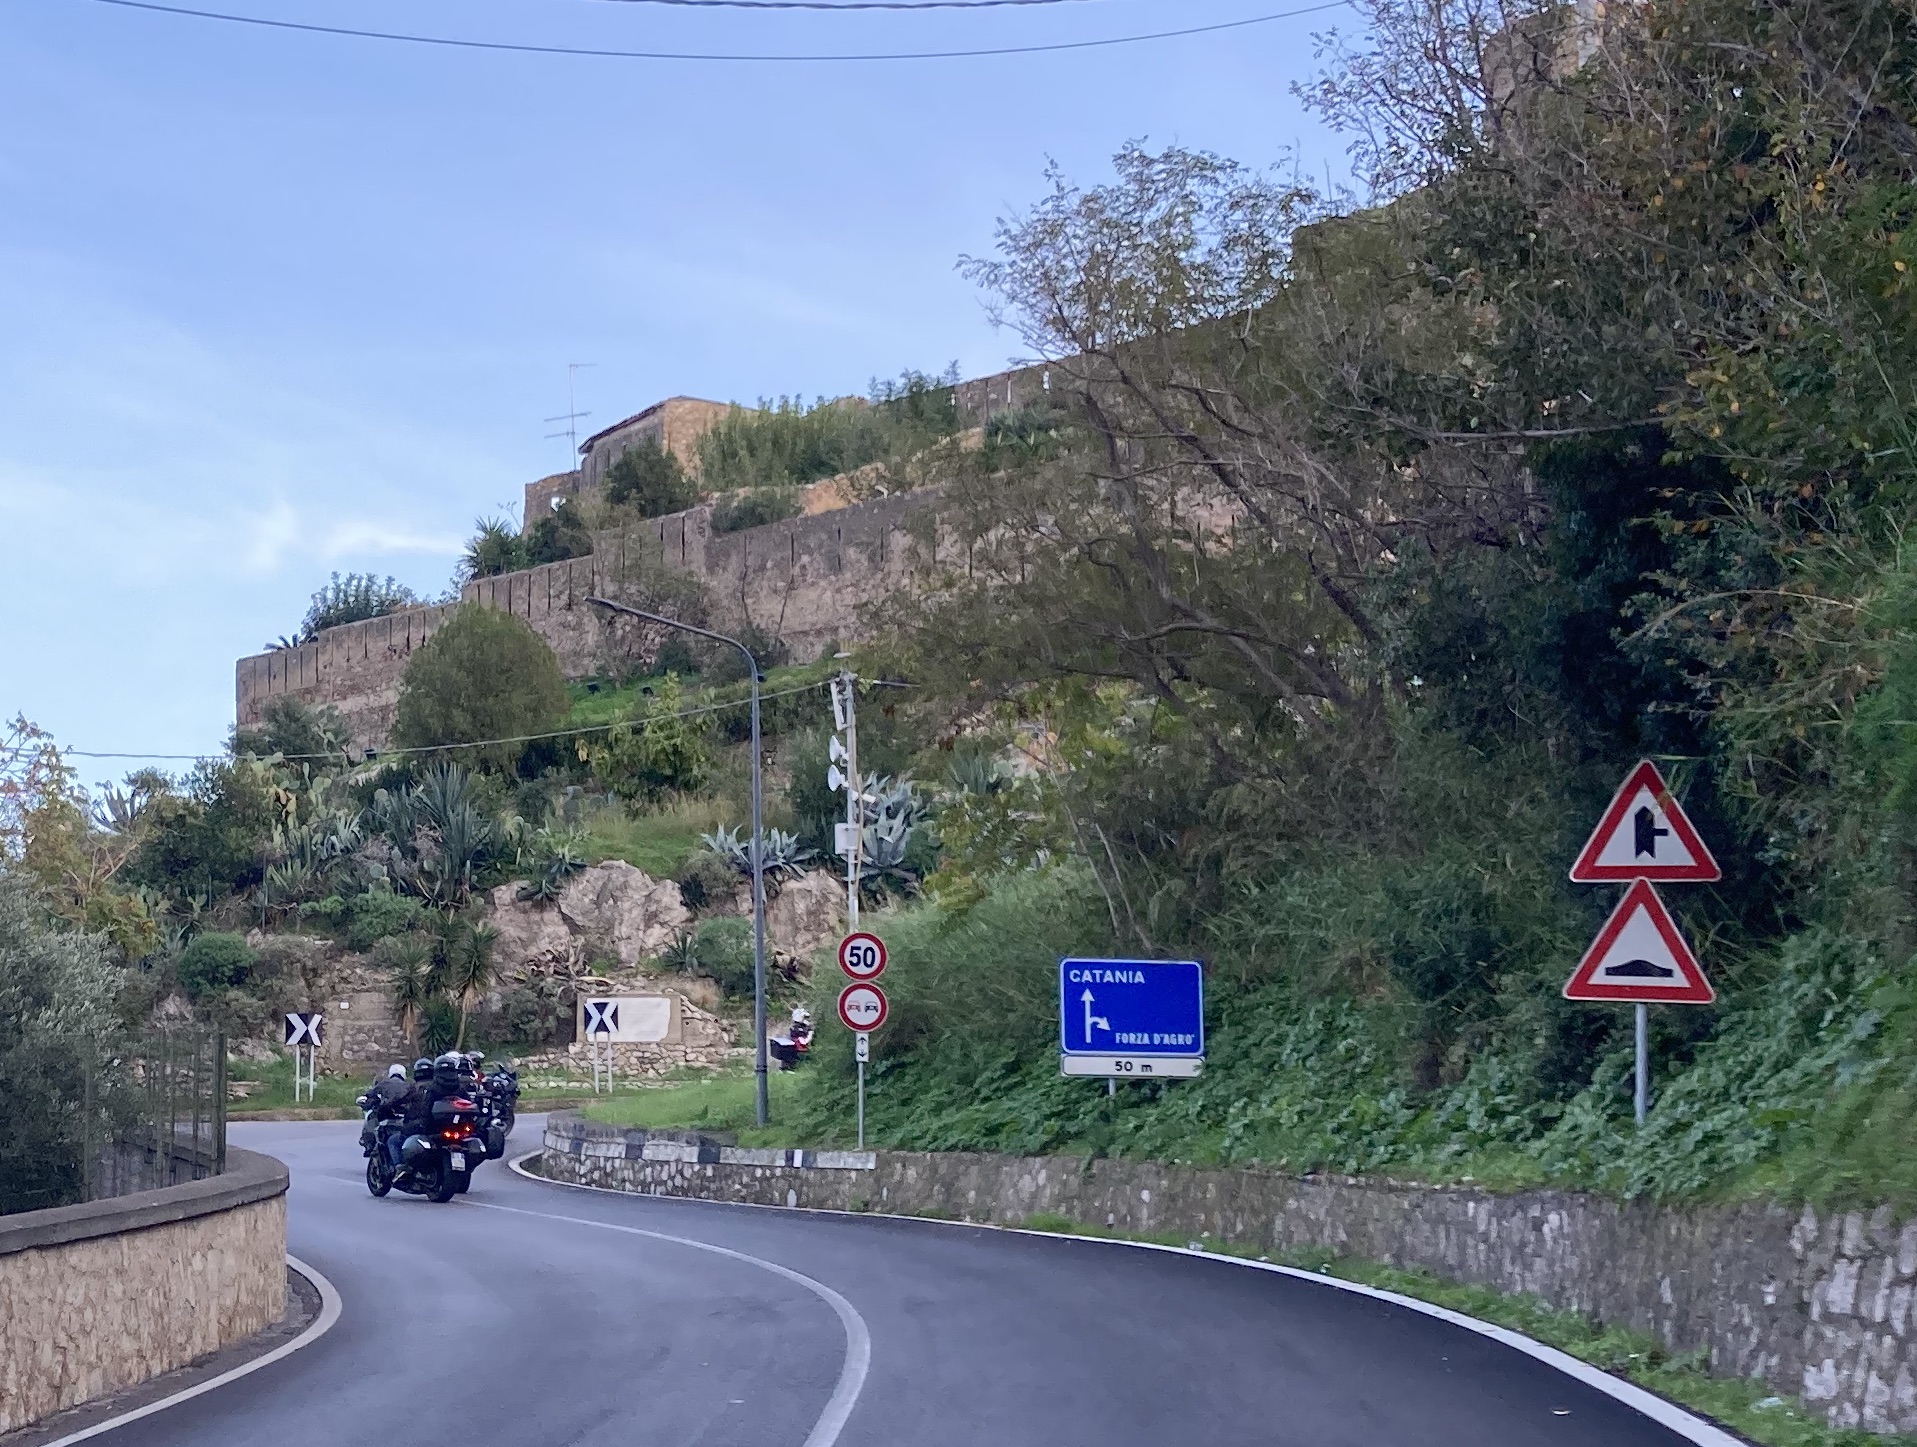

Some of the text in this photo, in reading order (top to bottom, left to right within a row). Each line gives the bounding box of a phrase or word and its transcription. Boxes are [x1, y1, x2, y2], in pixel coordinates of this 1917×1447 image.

[848, 946, 875, 968] 50
[1069, 970, 1145, 984] CATANIA
[1115, 1032, 1150, 1045] FORZA
[1115, 1061, 1153, 1073] 50 m
